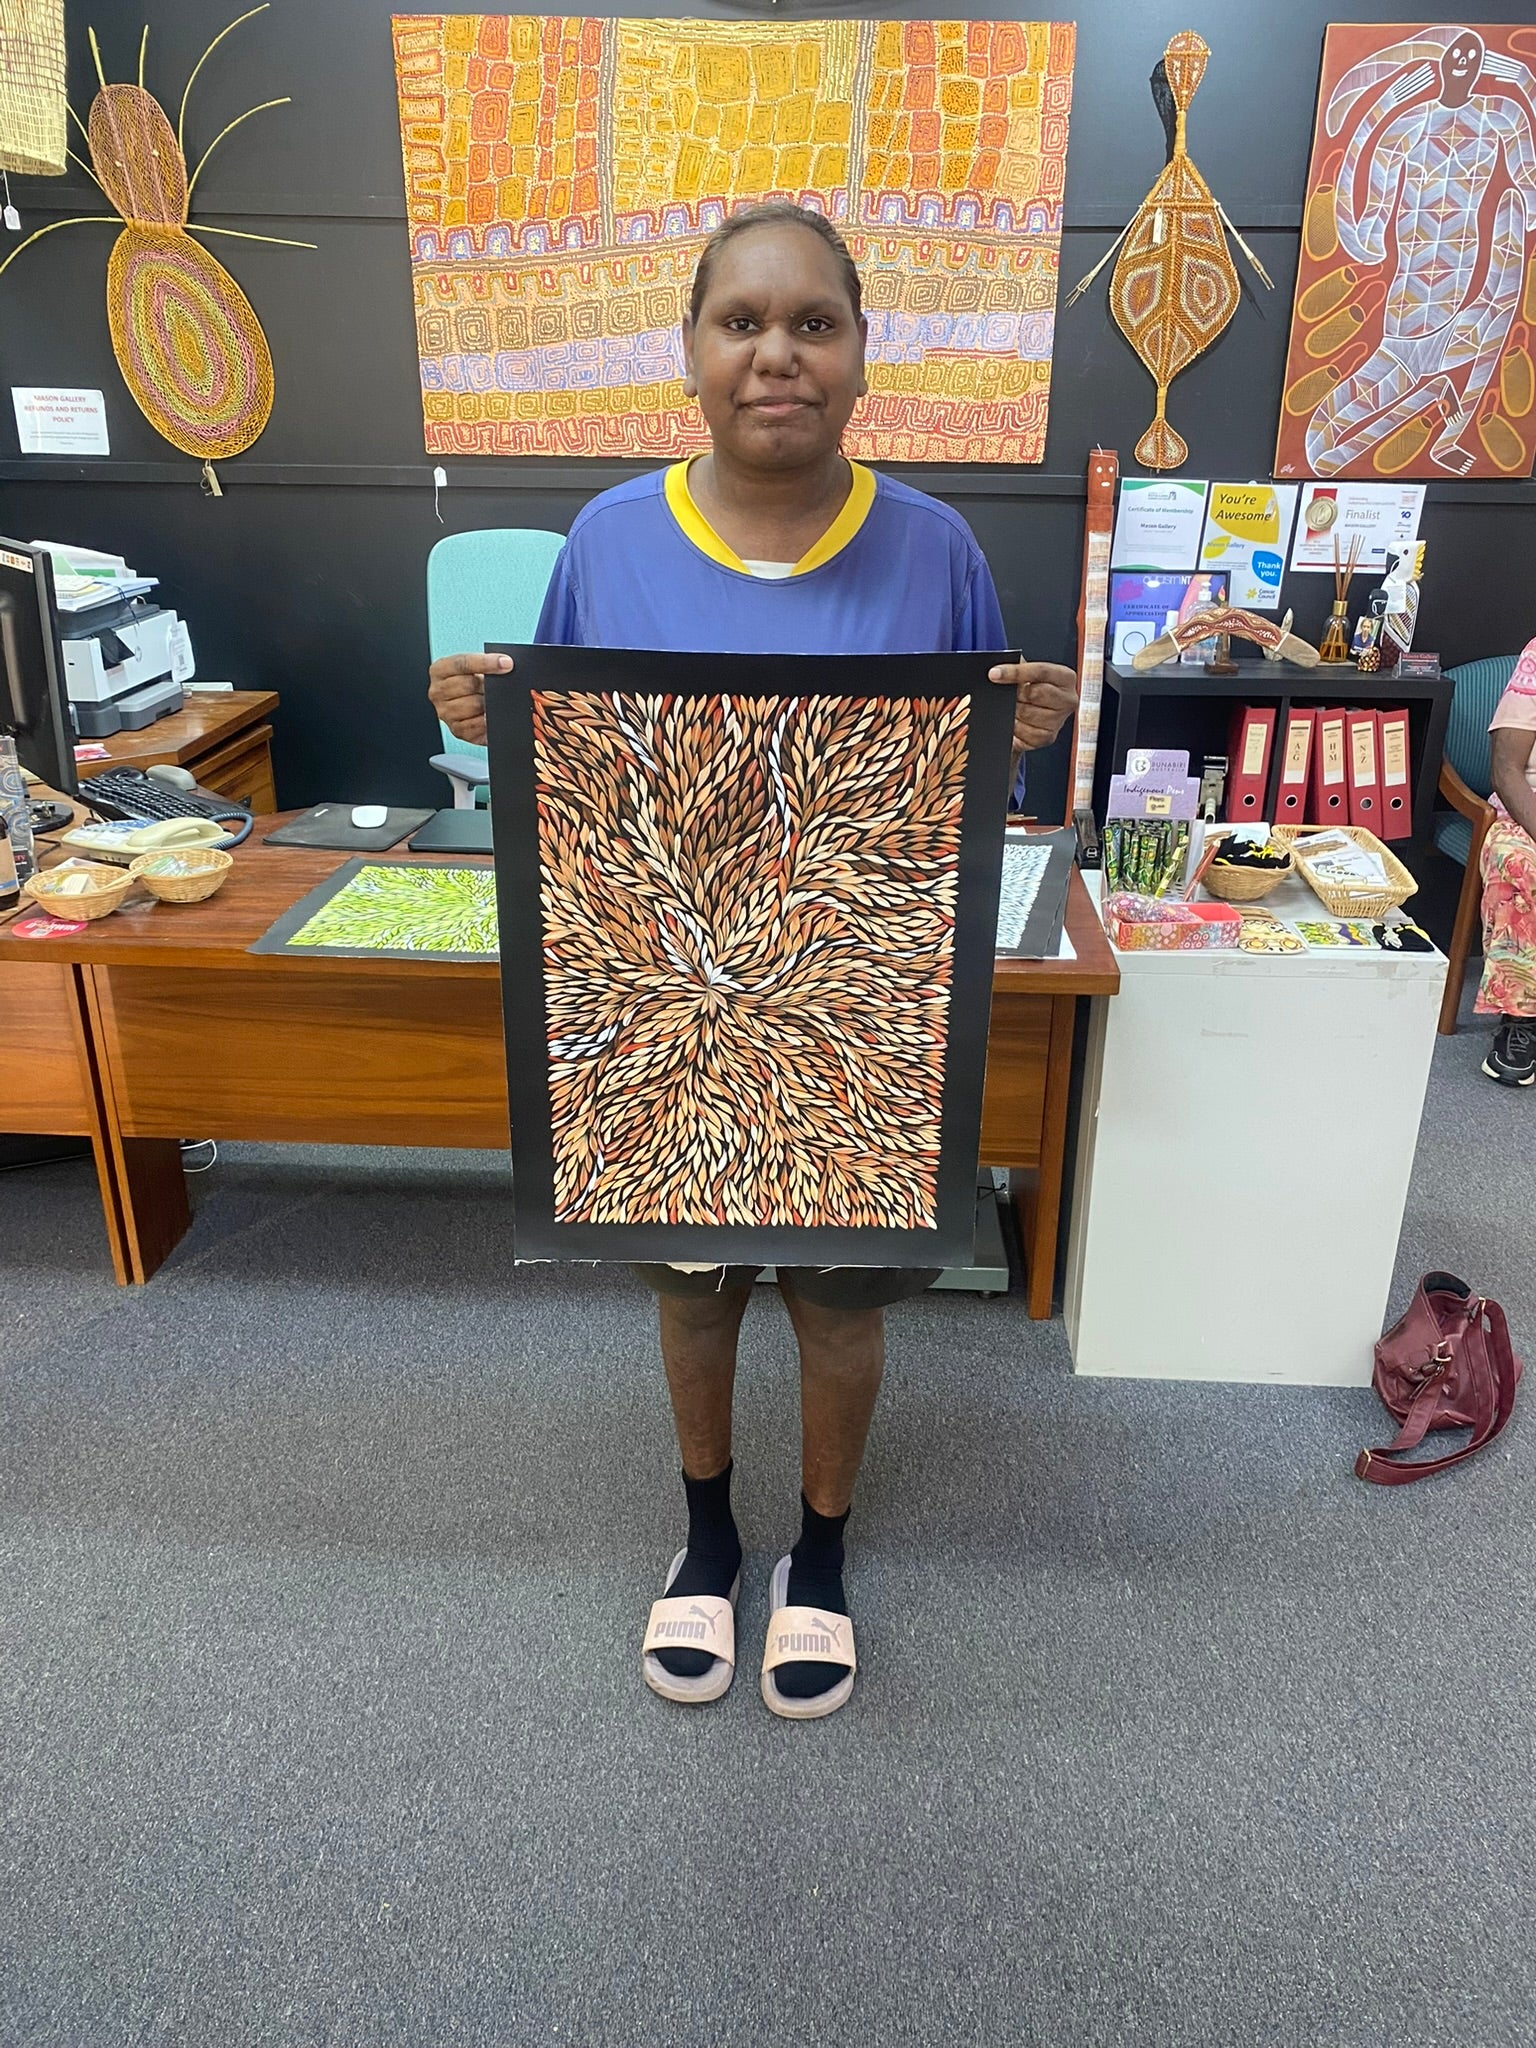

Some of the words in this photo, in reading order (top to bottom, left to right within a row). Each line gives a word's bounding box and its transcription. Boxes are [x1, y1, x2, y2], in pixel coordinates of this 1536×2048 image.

[1345, 509, 1381, 520] Finalist
[1226, 542, 1245, 550] Gallery
[1257, 561, 1281, 570] Thank
[1260, 570, 1278, 578] you.
[1294, 742, 1301, 750] A
[1329, 742, 1337, 750] H
[1123, 784, 1164, 797] Indigenous
[654, 1620, 707, 1640] PUMA
[778, 1633, 831, 1653] PUMA
